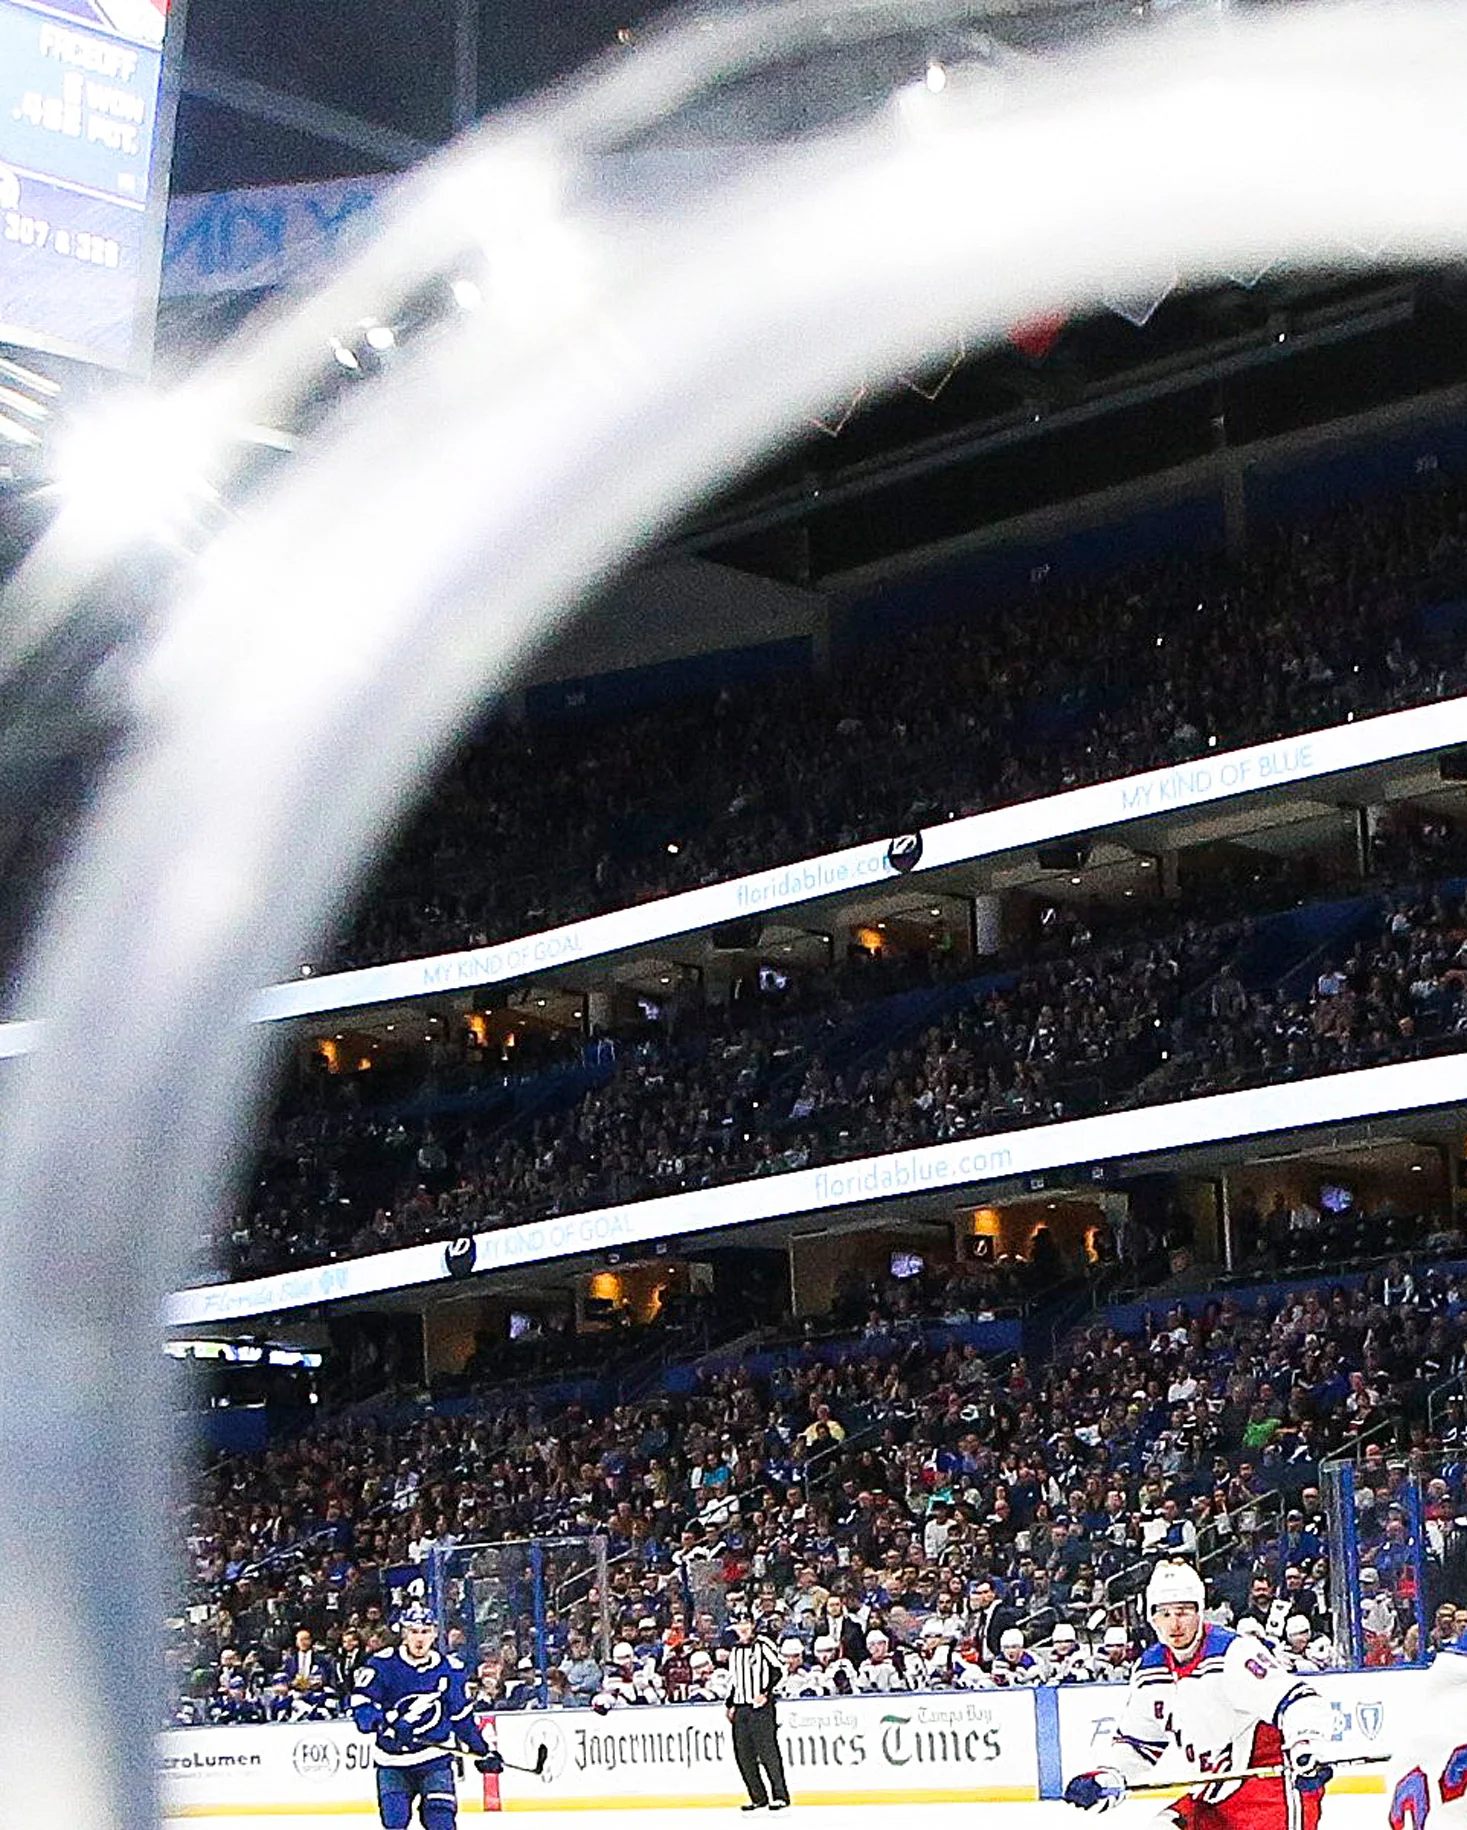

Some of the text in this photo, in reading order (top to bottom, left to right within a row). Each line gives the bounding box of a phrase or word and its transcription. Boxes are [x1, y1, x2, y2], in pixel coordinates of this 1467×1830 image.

[735, 852, 890, 910] floridablue.co
[813, 1143, 1014, 1203] floridablue.com
[786, 1732, 868, 1769] imes
[881, 1714, 1002, 1769] Times
